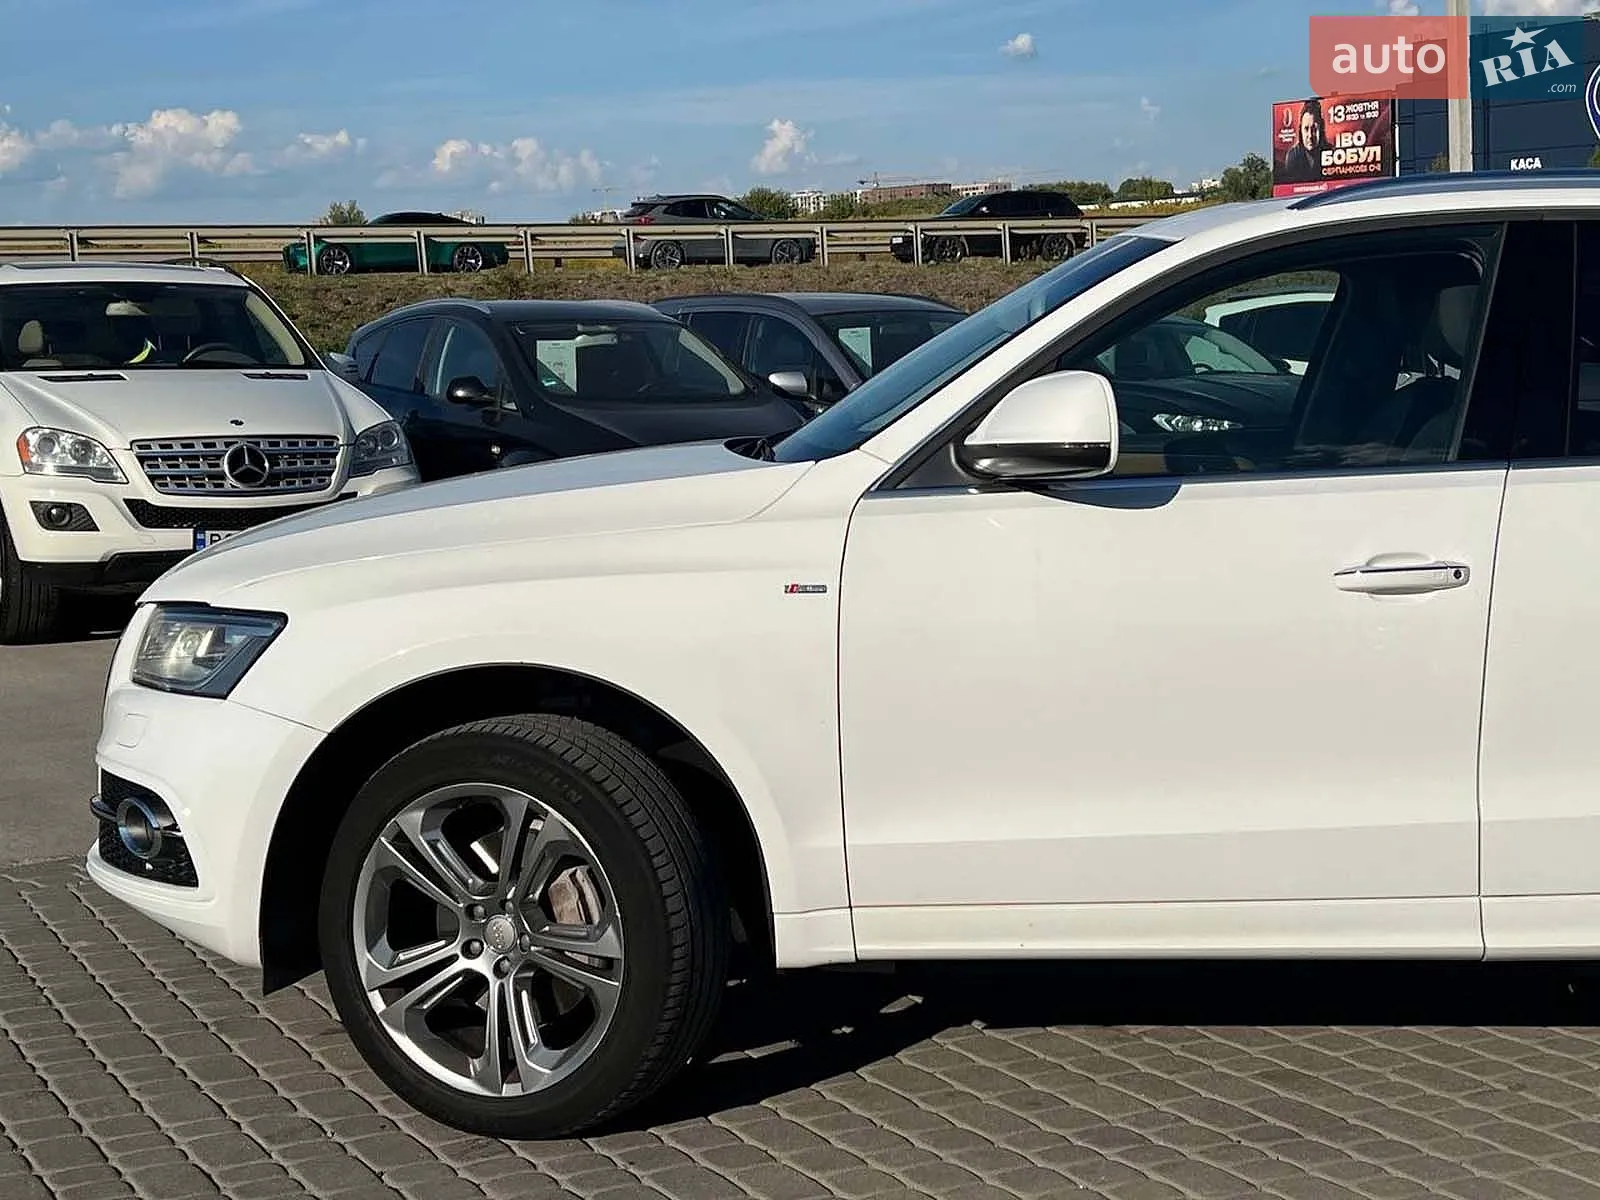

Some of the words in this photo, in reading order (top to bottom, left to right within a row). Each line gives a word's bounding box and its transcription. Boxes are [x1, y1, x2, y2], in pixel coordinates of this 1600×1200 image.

[1328, 105, 1345, 124] 13
[1345, 101, 1379, 113] ЖОВТНЯ
[1335, 130, 1366, 148] ІВО
[1321, 145, 1381, 166] БОБУЛ
[1510, 157, 1542, 170] КАСА
